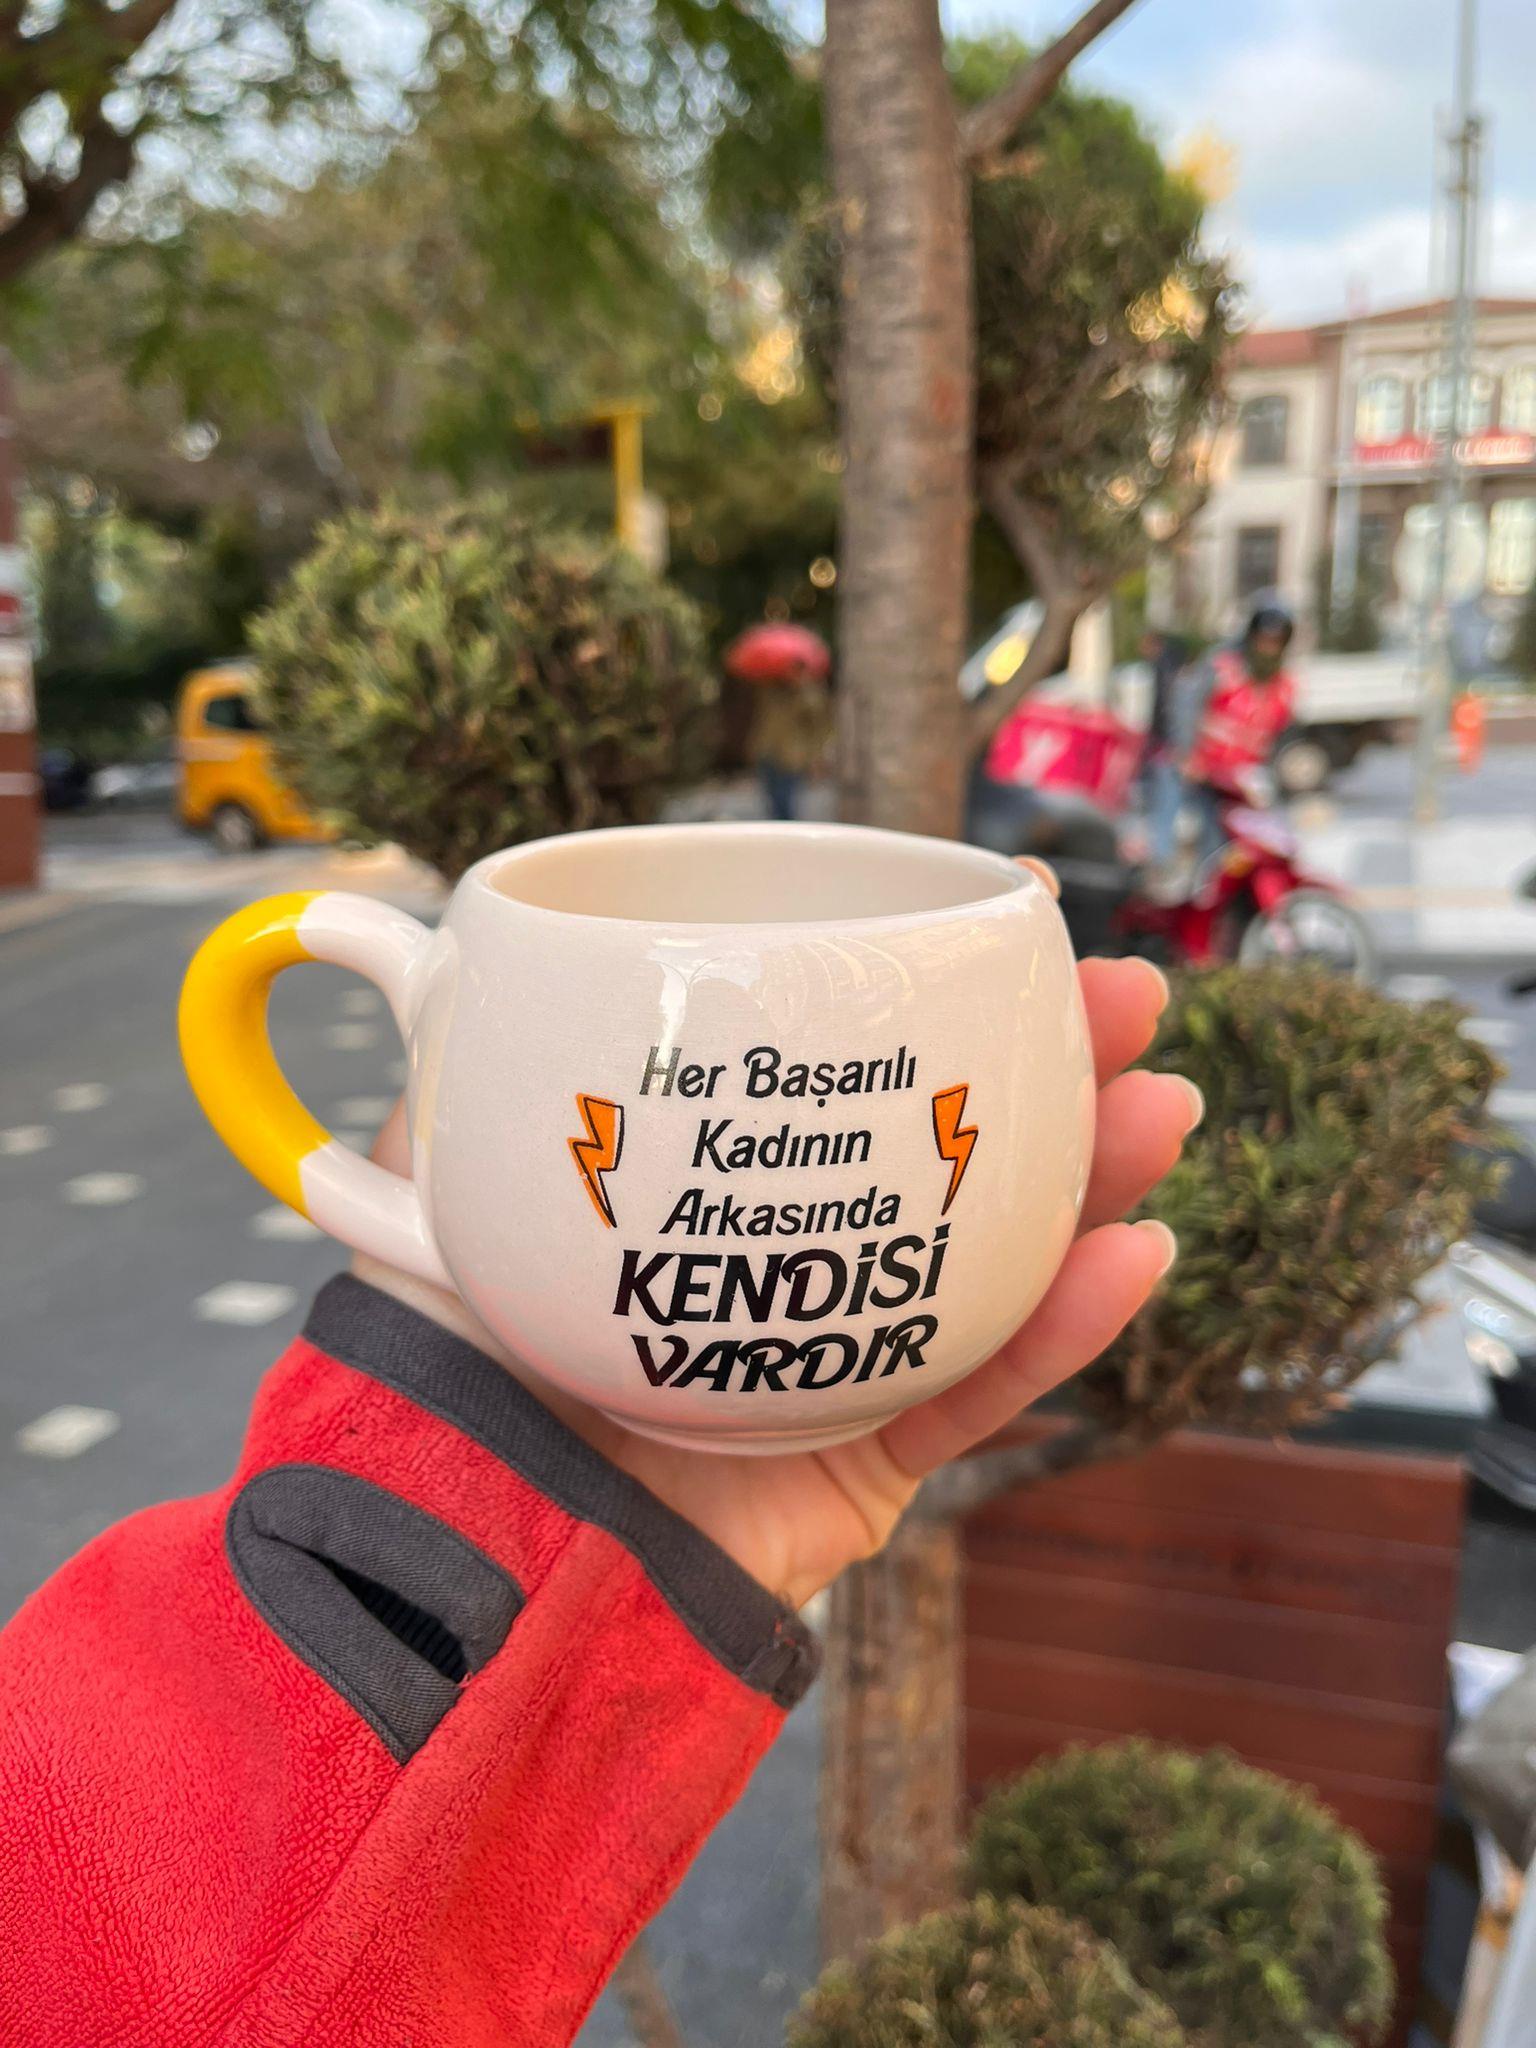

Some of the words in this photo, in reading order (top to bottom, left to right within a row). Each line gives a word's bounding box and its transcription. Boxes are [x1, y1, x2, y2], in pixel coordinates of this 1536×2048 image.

[638, 1046, 727, 1099] Her
[743, 1045, 917, 1108] Başarılı
[691, 1118, 872, 1174] Kadının
[659, 1186, 902, 1237] Arkasında
[630, 1314, 938, 1393] VARDIR
